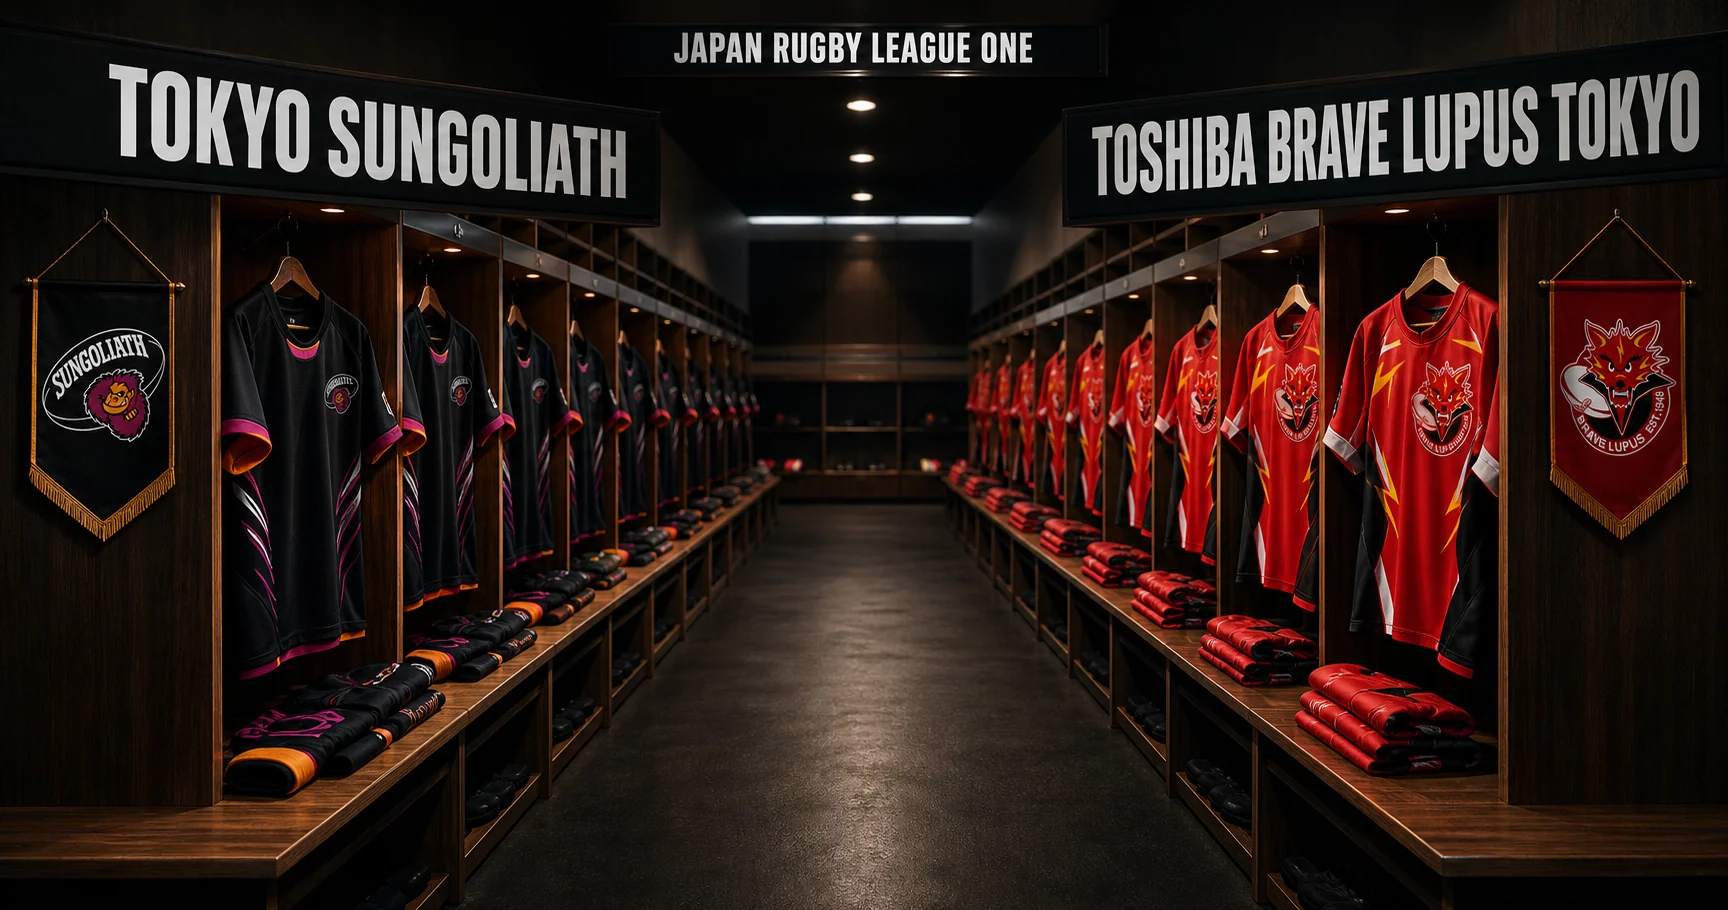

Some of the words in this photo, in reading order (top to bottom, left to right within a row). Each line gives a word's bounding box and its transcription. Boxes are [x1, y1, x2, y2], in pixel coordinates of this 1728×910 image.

[674, 32, 762, 64] JAPAN
[773, 32, 863, 64] RUGBY
[871, 32, 971, 64] LEAGUE
[981, 32, 1033, 64] ONE
[109, 64, 310, 174] TOKYO
[328, 97, 627, 199] SUNGOLIATH
[1091, 112, 1257, 196] TOSHIBA
[1268, 98, 1390, 184] BRAVE
[1402, 85, 1539, 174] LUPUS
[1551, 69, 1700, 162] TOKYO
[52, 334, 149, 400] SUNGOLIATH
[1576, 414, 1607, 450] BRAVE
[1608, 433, 1646, 453] LUPUS
